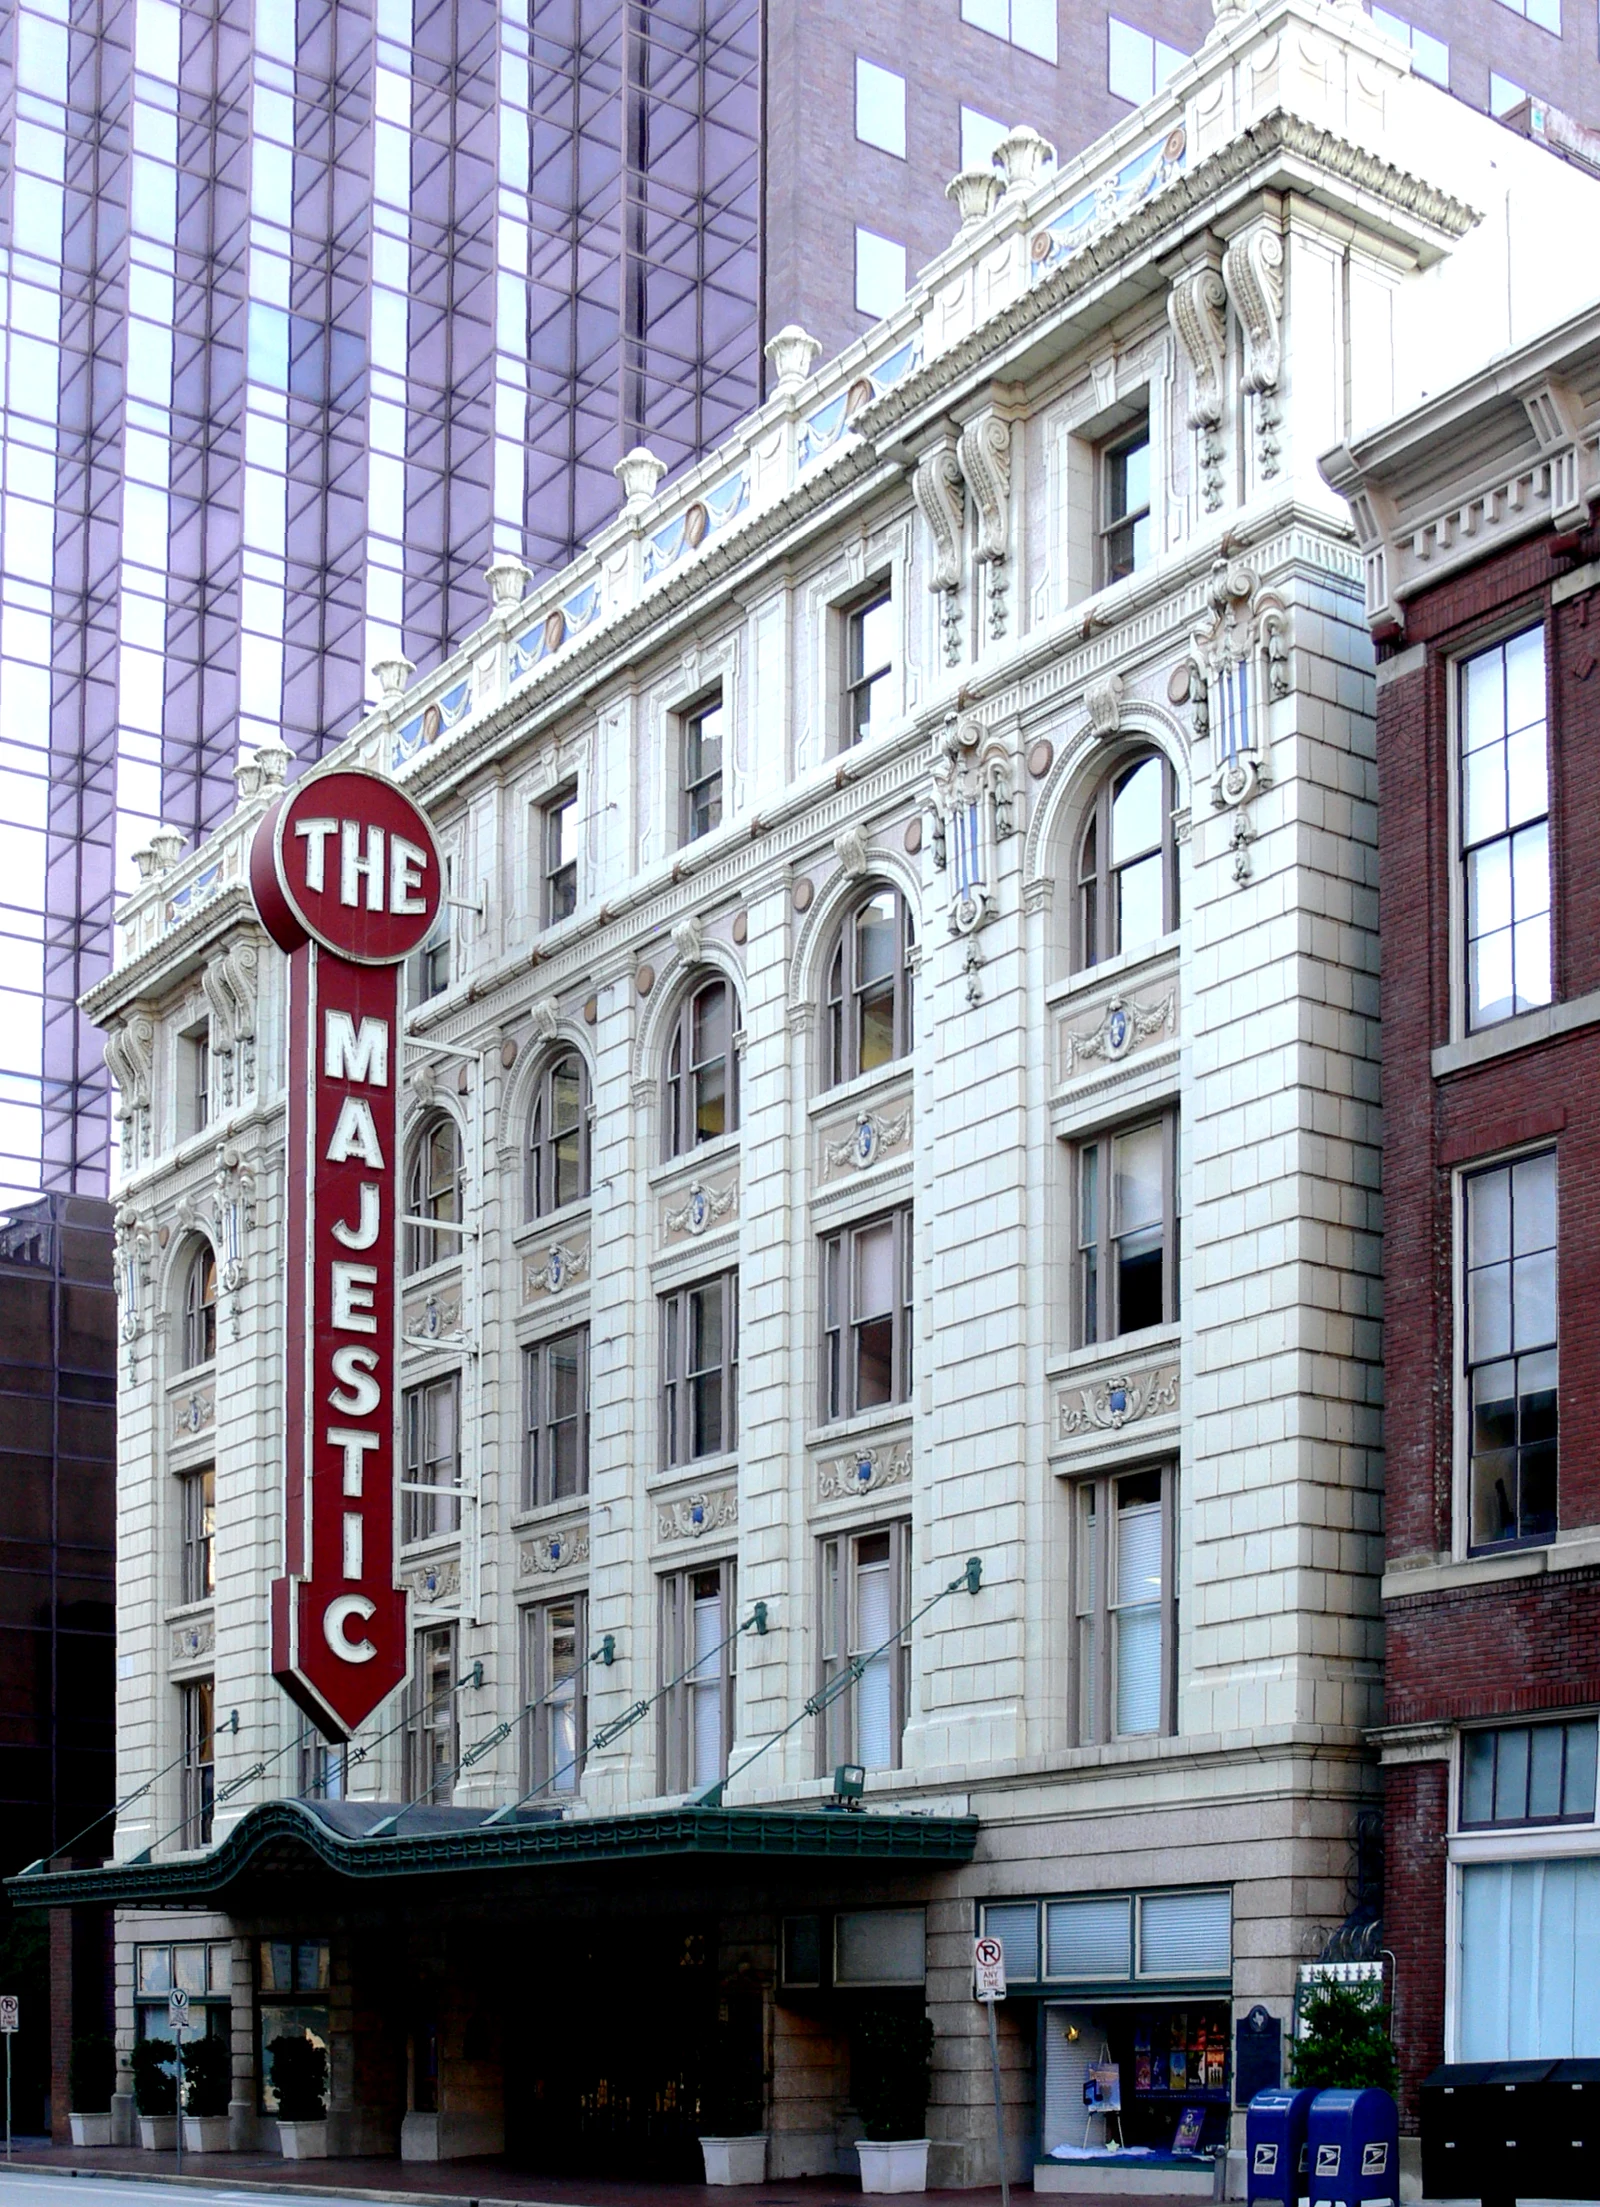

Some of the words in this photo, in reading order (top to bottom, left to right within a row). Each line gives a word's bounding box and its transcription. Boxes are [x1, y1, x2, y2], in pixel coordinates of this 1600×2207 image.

[295, 818, 427, 914] THE
[323, 1008, 389, 1664] MAJESTIC
[984, 1945, 995, 1961] P
[984, 1971, 998, 1979] ANY
[983, 1979, 999, 1988] TIME
[174, 1994, 183, 2005] V
